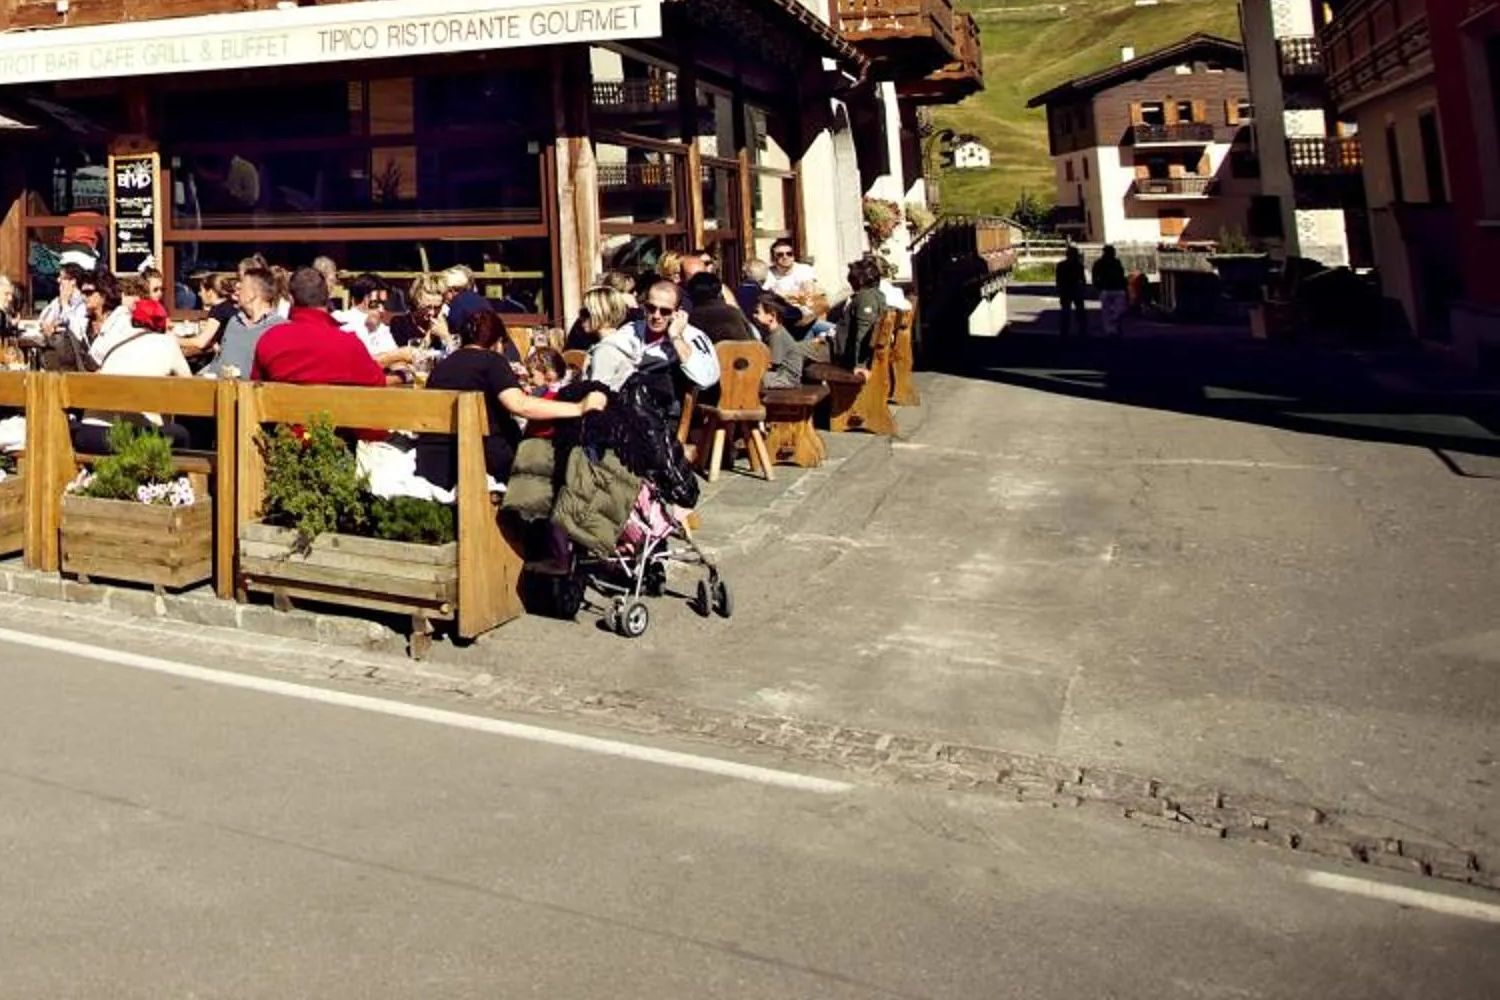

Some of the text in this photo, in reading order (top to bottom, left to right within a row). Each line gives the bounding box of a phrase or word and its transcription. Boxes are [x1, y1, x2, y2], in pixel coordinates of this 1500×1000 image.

[317, 5, 641, 52] TIPICO RISTORANTE GOURMET
[45, 51, 79, 73] BAR
[143, 40, 191, 66] GRILL
[200, 38, 212, 61] &
[222, 34, 290, 61] BUFFET
